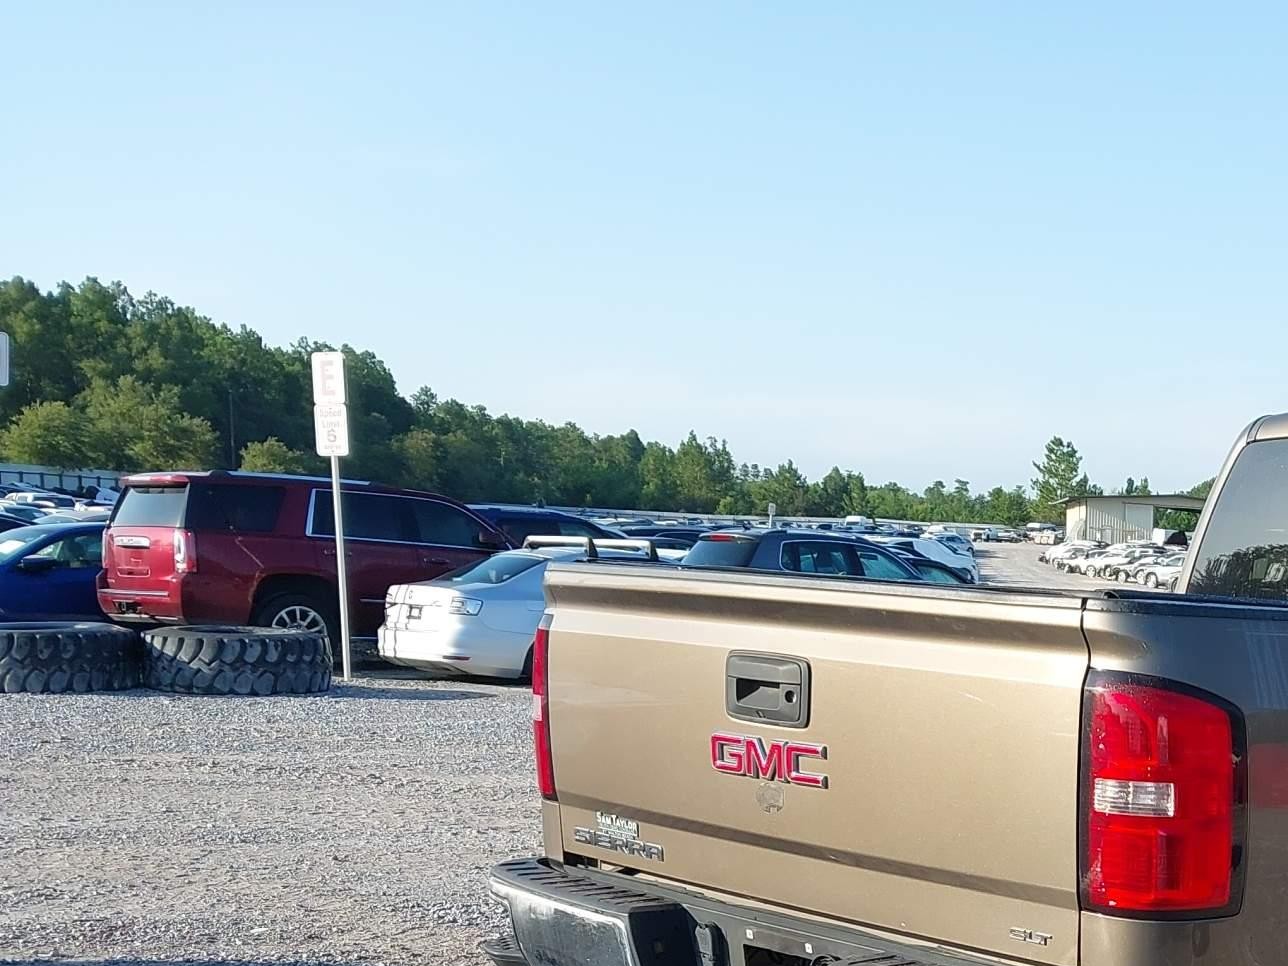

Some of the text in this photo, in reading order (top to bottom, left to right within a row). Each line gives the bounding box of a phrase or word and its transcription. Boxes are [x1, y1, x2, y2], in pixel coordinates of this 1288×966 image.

[320, 359, 336, 396] E
[710, 732, 829, 790] GMC
[574, 826, 665, 863] SIERRA
[1008, 927, 1053, 947] SLT
